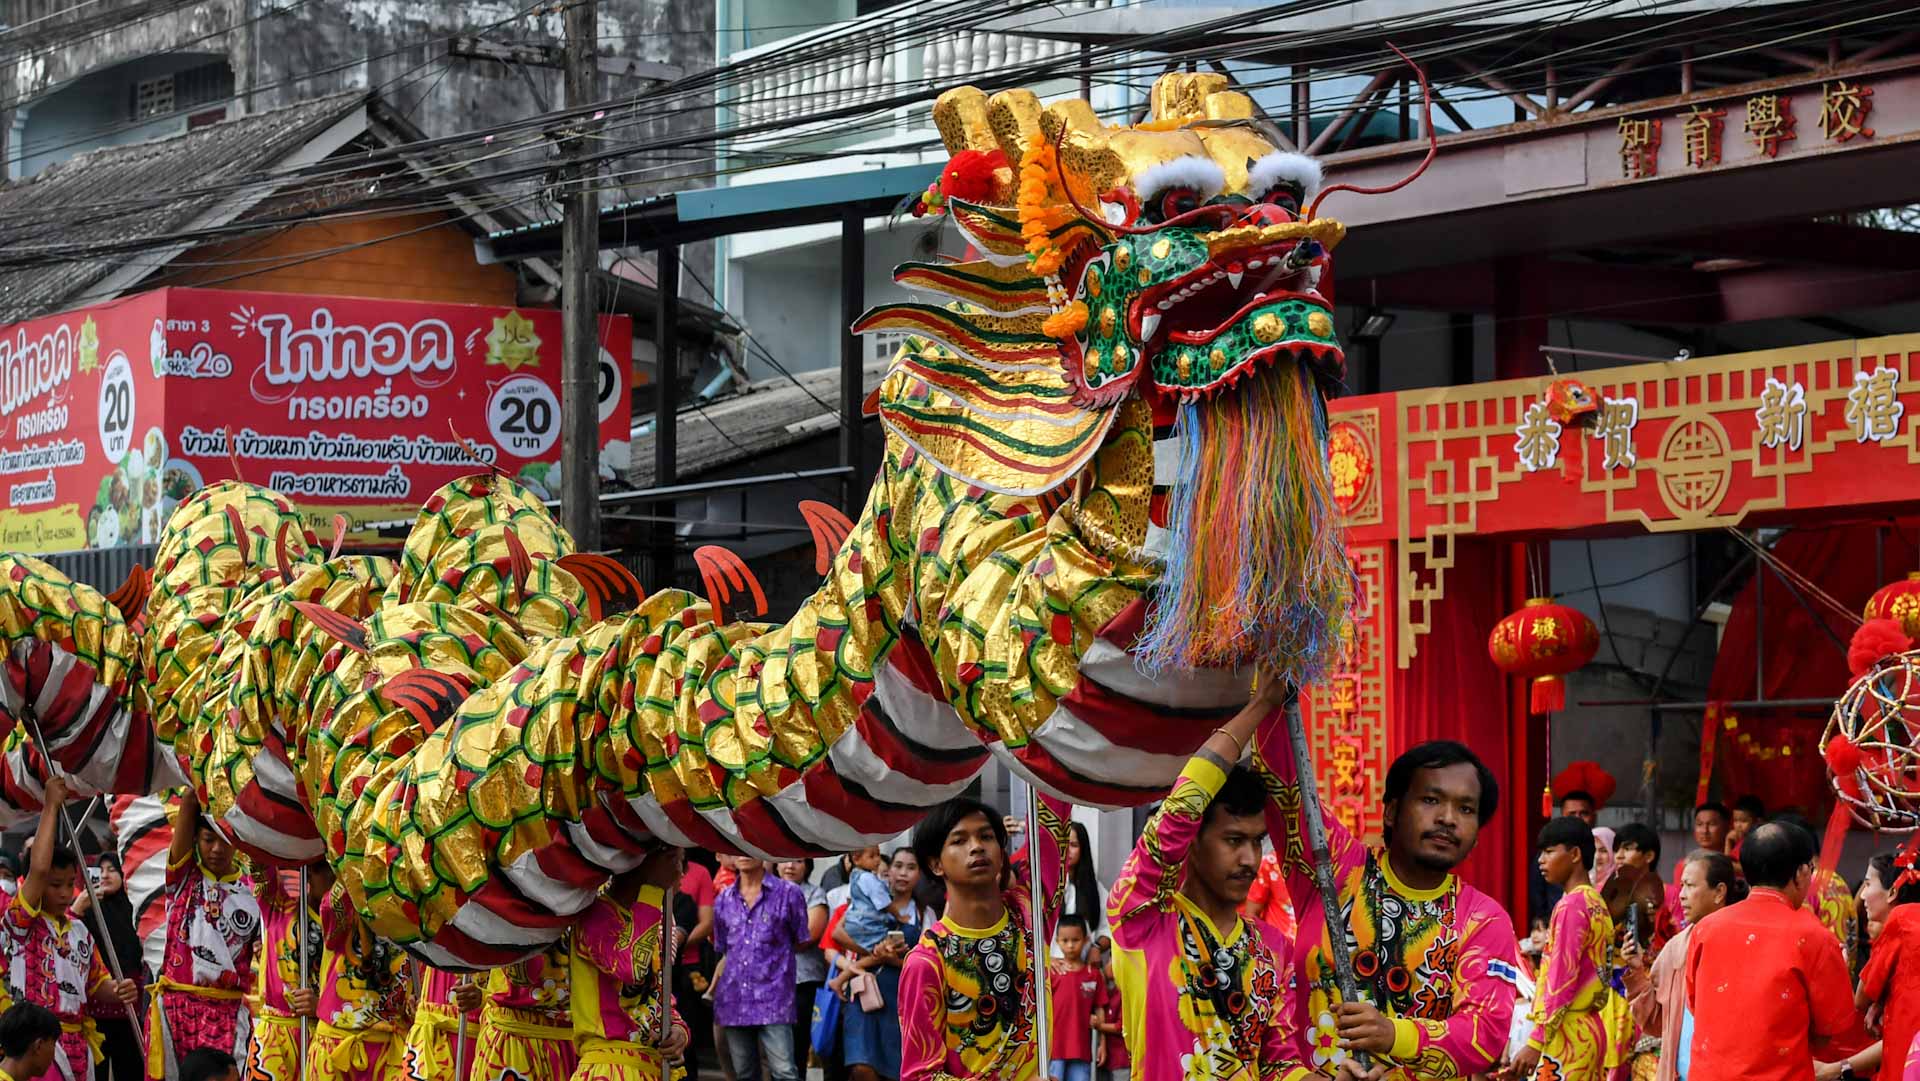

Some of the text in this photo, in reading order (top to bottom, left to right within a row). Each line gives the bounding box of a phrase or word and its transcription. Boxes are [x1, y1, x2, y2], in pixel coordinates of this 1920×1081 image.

[1616, 79, 1874, 180] 智育學校
[166, 319, 211, 334] สาขา 3
[257, 307, 456, 386] ไก่ทอด
[103, 380, 131, 433] 20
[288, 377, 429, 421] ทรงเครื่อง
[499, 396, 552, 435] 20
[109, 435, 125, 452] บาท
[308, 432, 414, 462] ข้าวมันอาหรับ
[512, 436, 541, 449] บาท
[271, 468, 409, 497] และอาหารตามสั่ง
